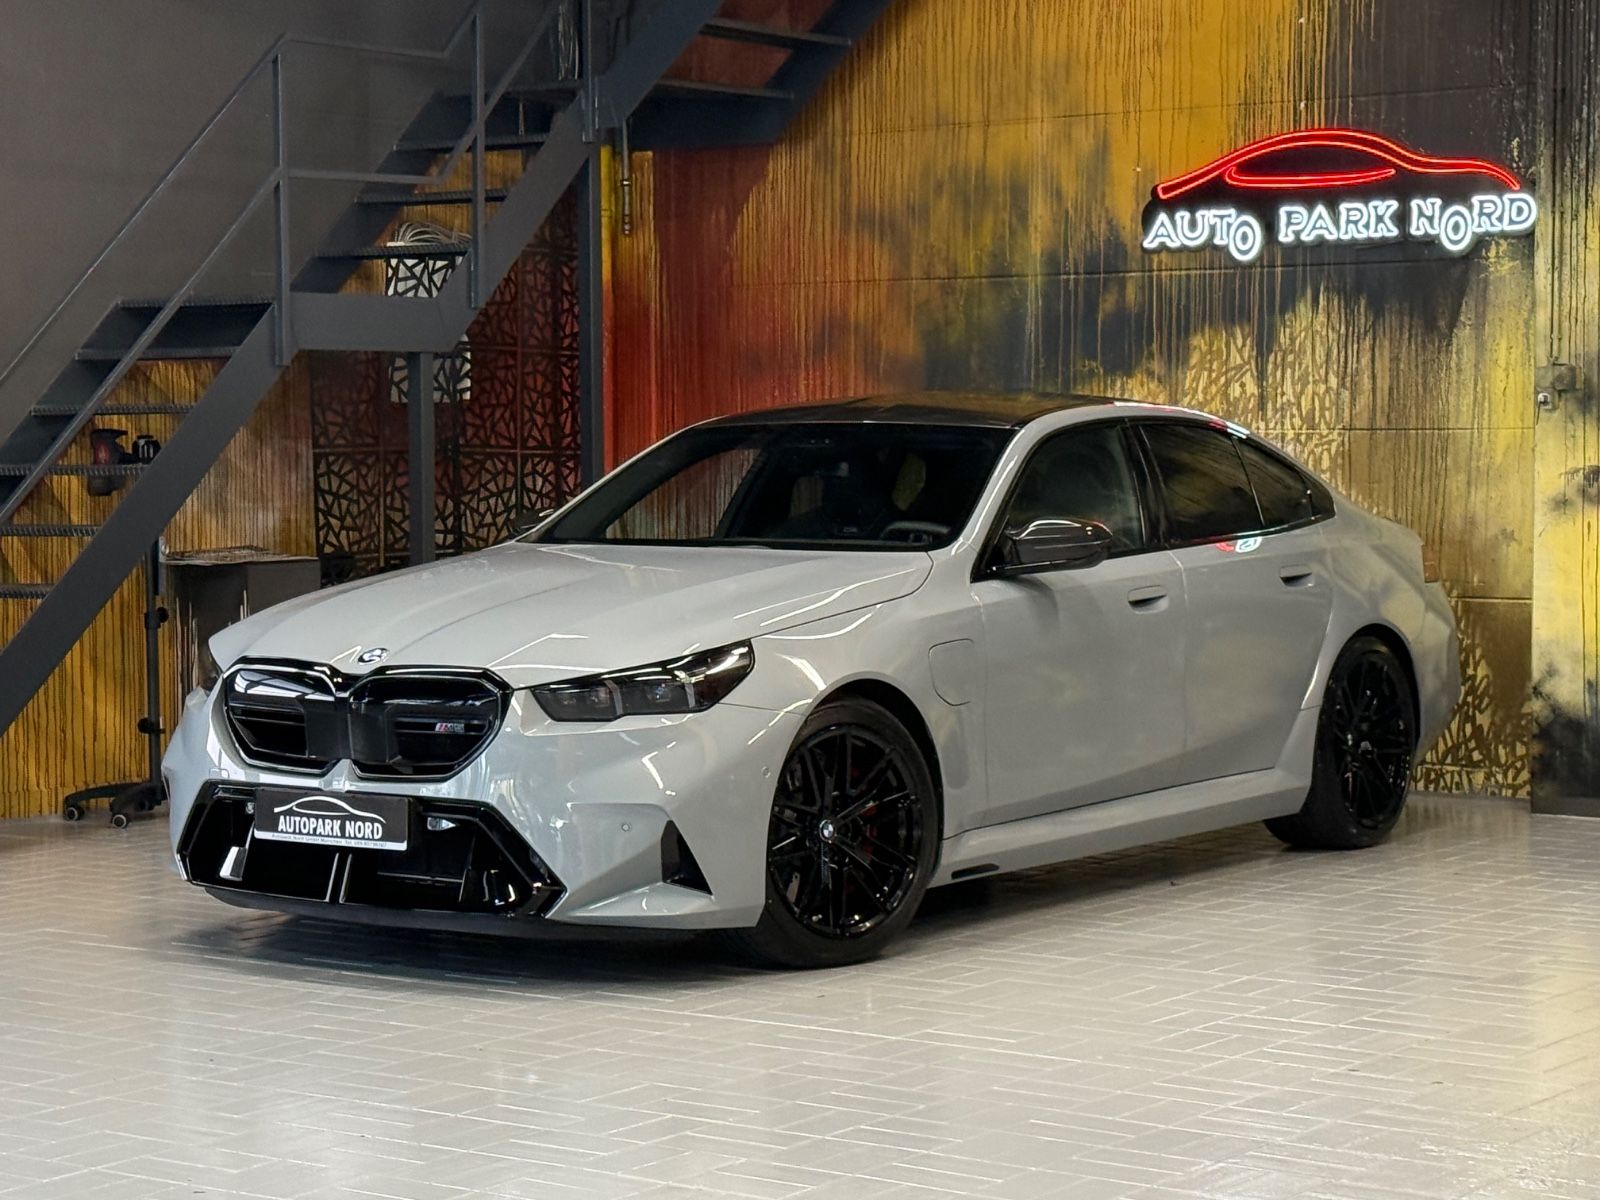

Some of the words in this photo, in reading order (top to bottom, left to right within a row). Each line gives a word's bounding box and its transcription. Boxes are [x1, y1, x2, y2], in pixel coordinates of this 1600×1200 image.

[1142, 207, 1262, 261] AUTO
[1278, 199, 1400, 243] PARK
[1409, 192, 1538, 251] NORD
[277, 814, 342, 837] AUTOPARK
[345, 821, 383, 840] NORD
